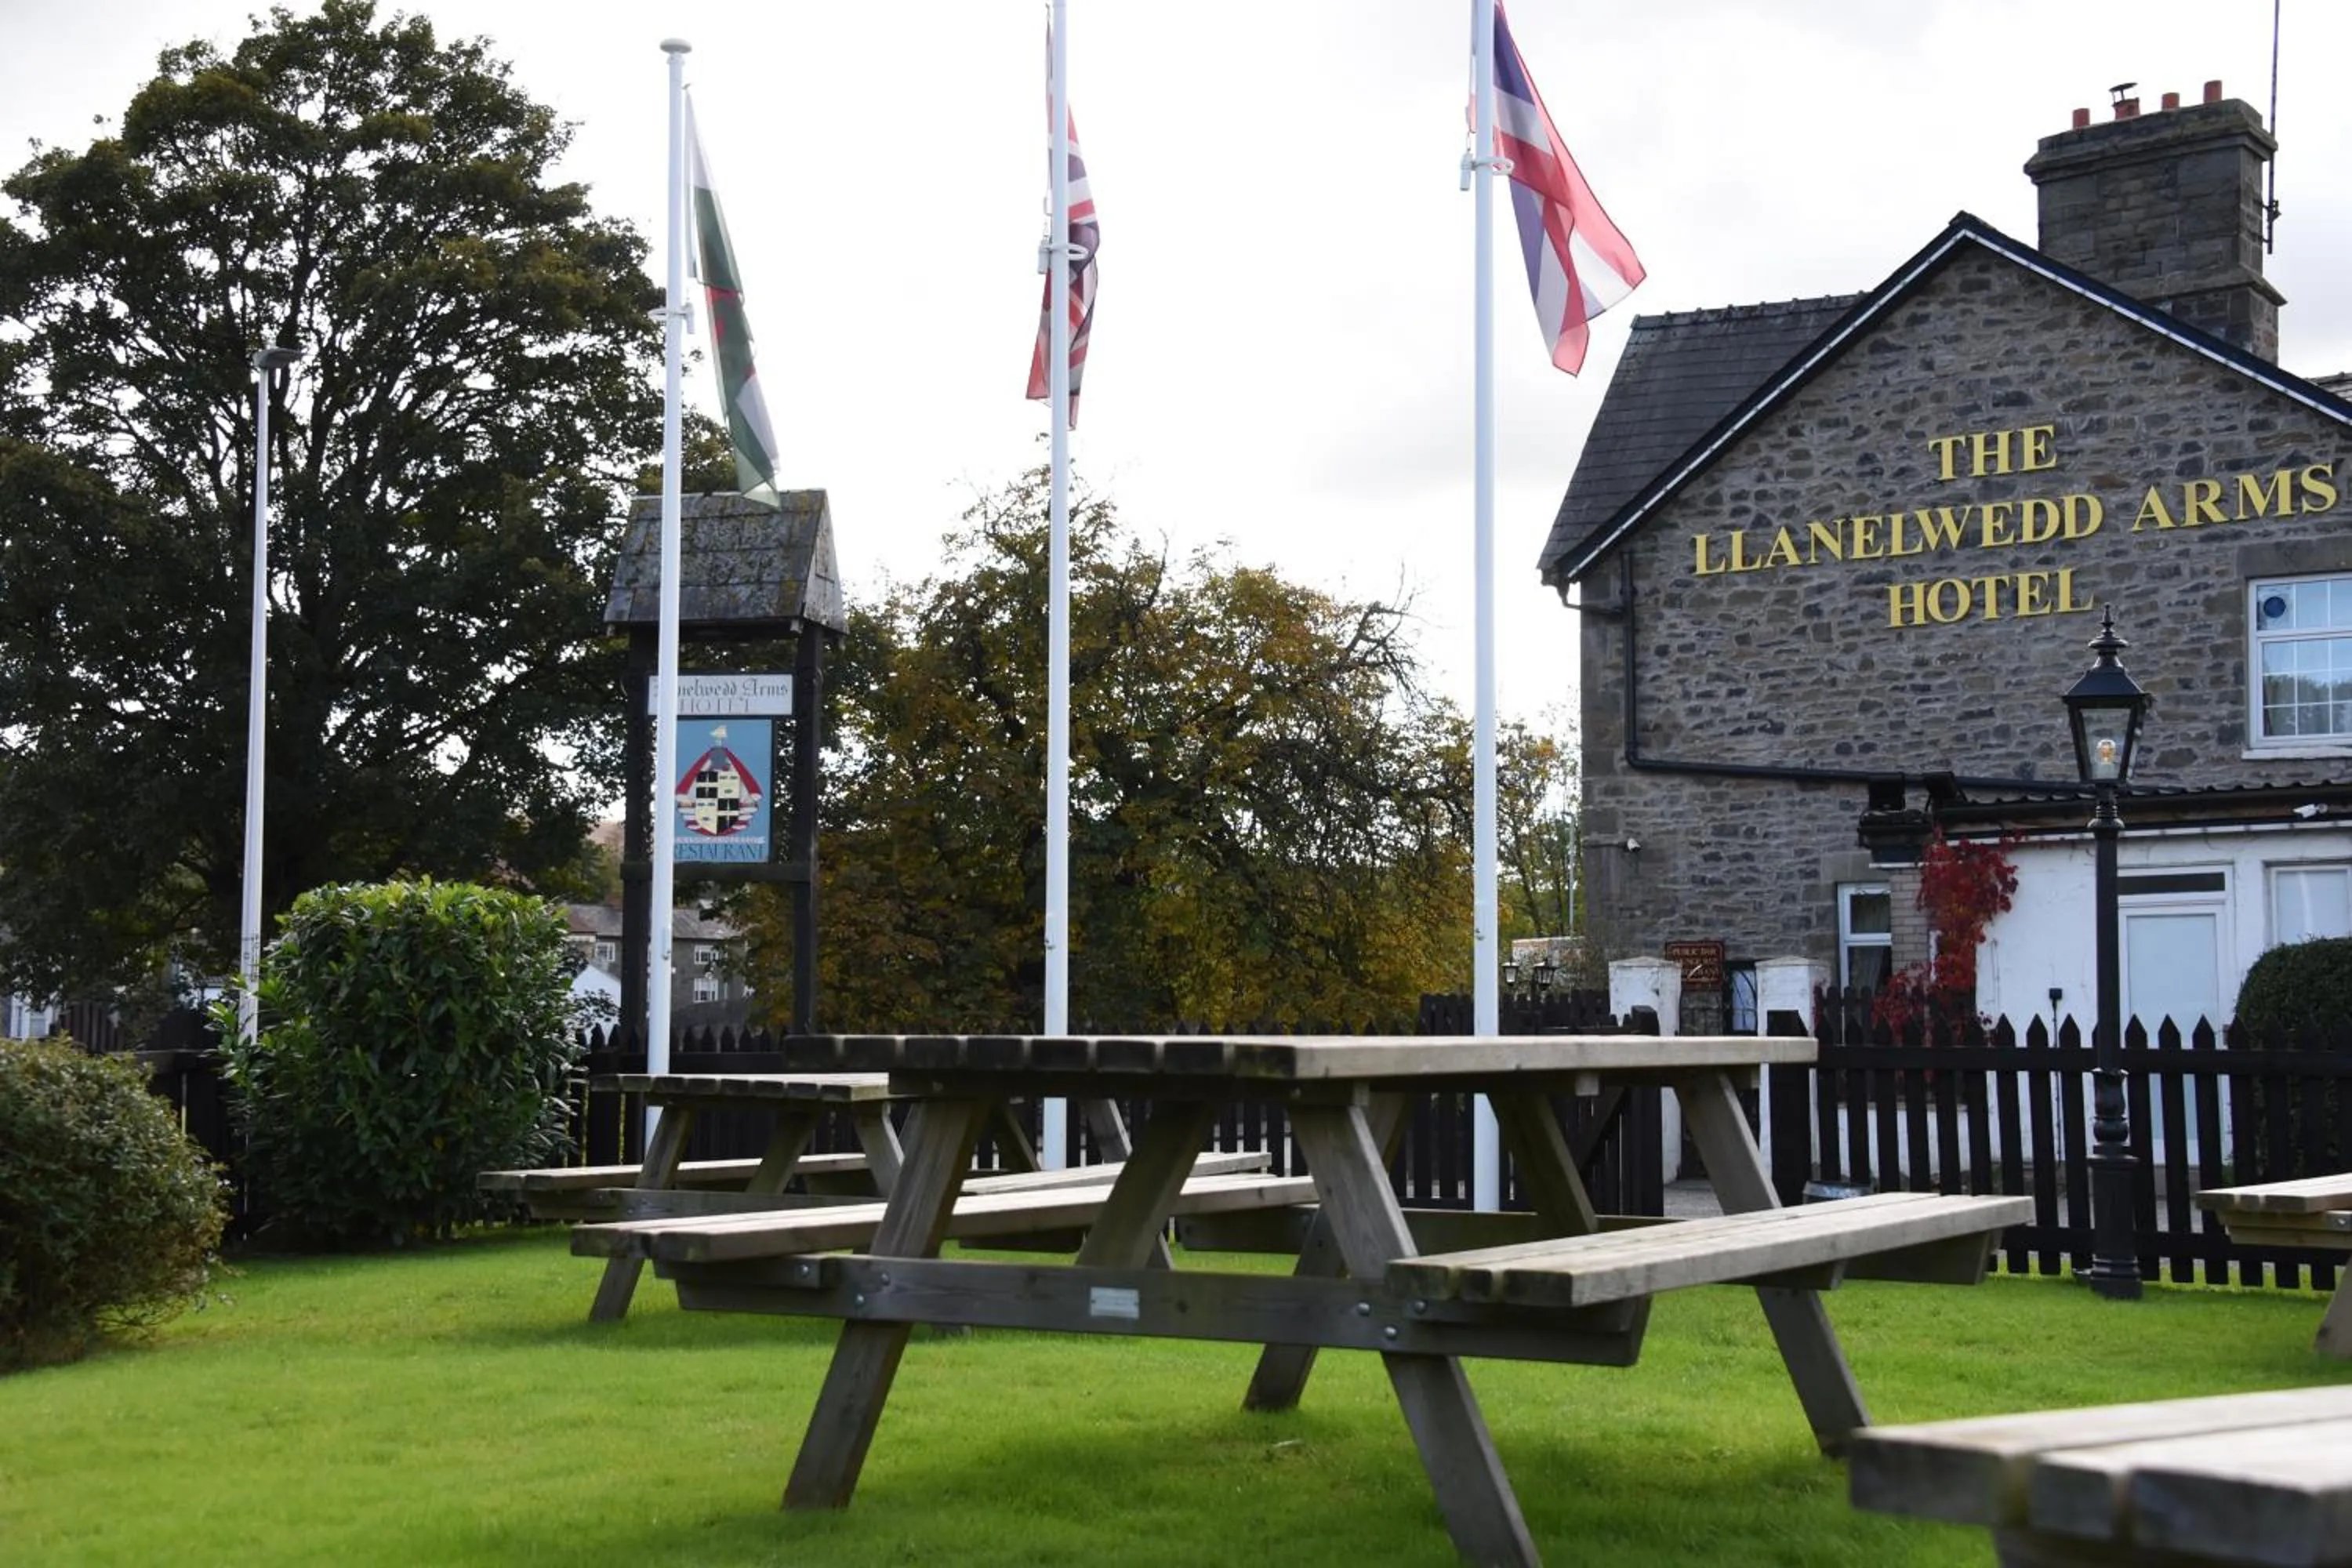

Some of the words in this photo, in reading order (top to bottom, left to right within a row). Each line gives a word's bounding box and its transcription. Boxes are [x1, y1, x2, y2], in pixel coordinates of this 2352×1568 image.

[1928, 424, 2056, 481] THE
[1692, 494, 2104, 575] LLANELWEDD
[2131, 463, 2339, 532] ARMS
[1886, 568, 2094, 628] HOTEL
[652, 677, 737, 698] nelwedd
[742, 677, 789, 698] Arms
[674, 842, 764, 861] ESTAURANT
